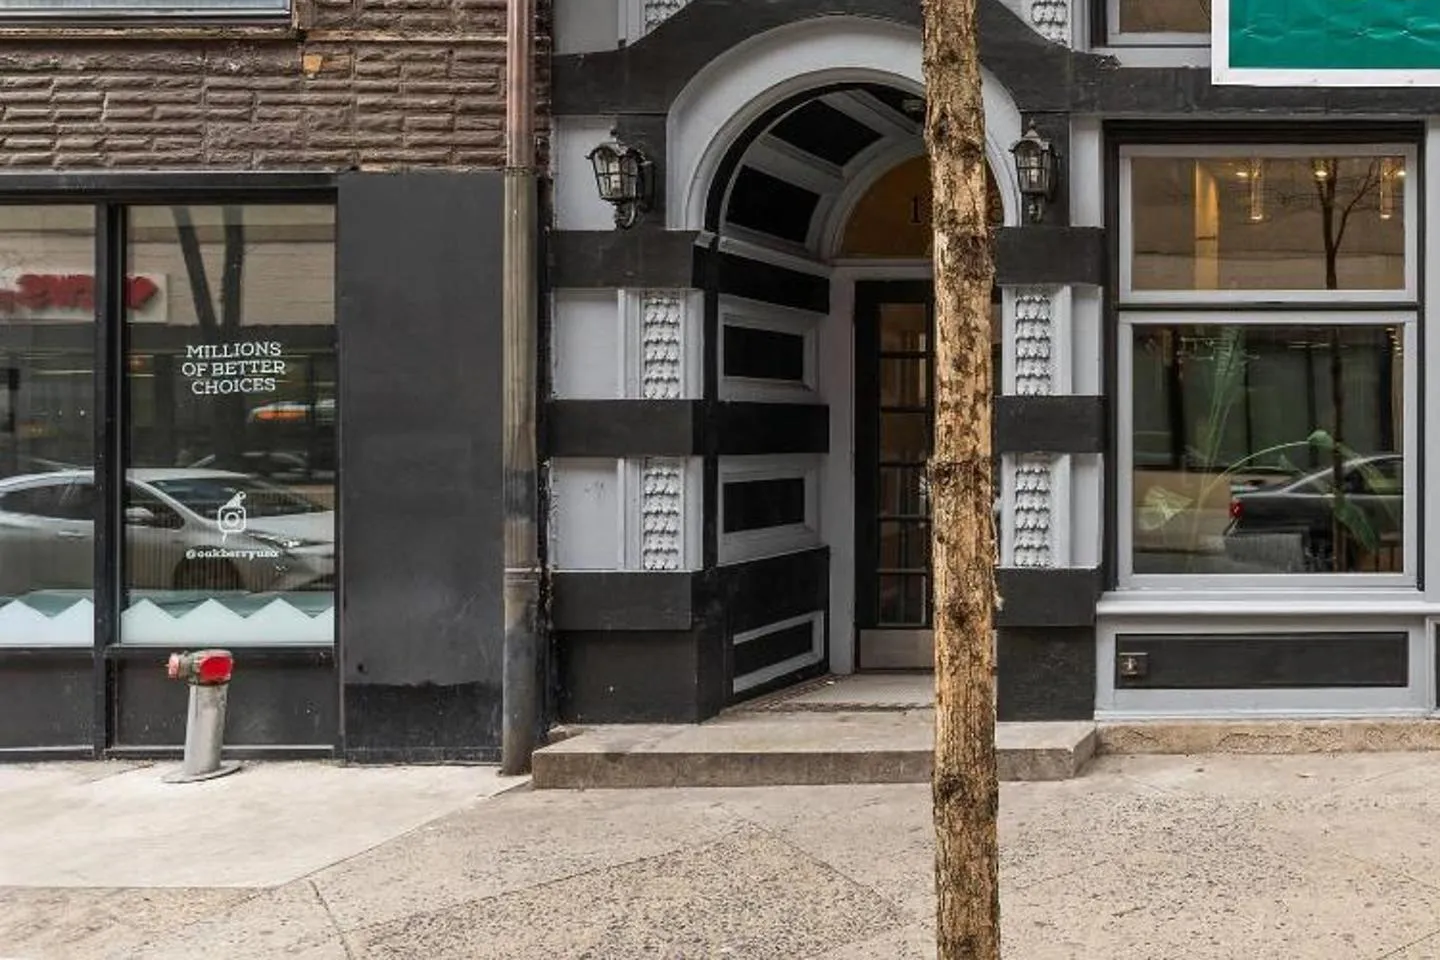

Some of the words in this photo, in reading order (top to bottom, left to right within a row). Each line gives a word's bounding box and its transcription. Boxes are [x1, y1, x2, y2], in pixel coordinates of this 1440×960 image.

[186, 341, 282, 359] MILLIONS
[181, 361, 208, 377] OF
[211, 359, 286, 377] BETTER
[191, 377, 276, 395] CHOICES
